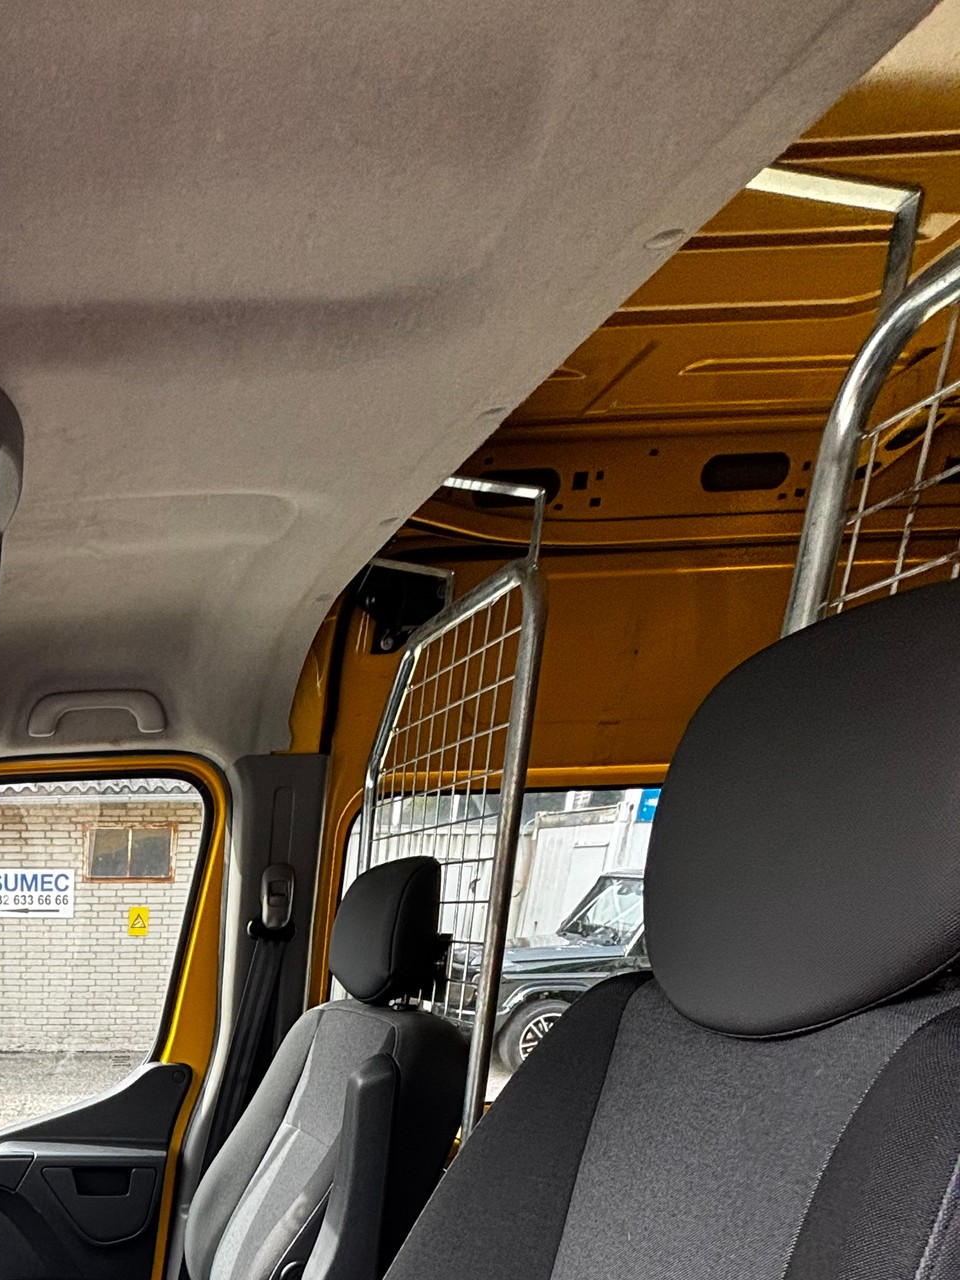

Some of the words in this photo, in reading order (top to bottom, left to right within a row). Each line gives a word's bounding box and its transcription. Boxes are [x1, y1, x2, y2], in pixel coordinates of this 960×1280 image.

[13, 895, 34, 906] 633
[37, 895, 52, 906] 66
[54, 895, 69, 906] 66
